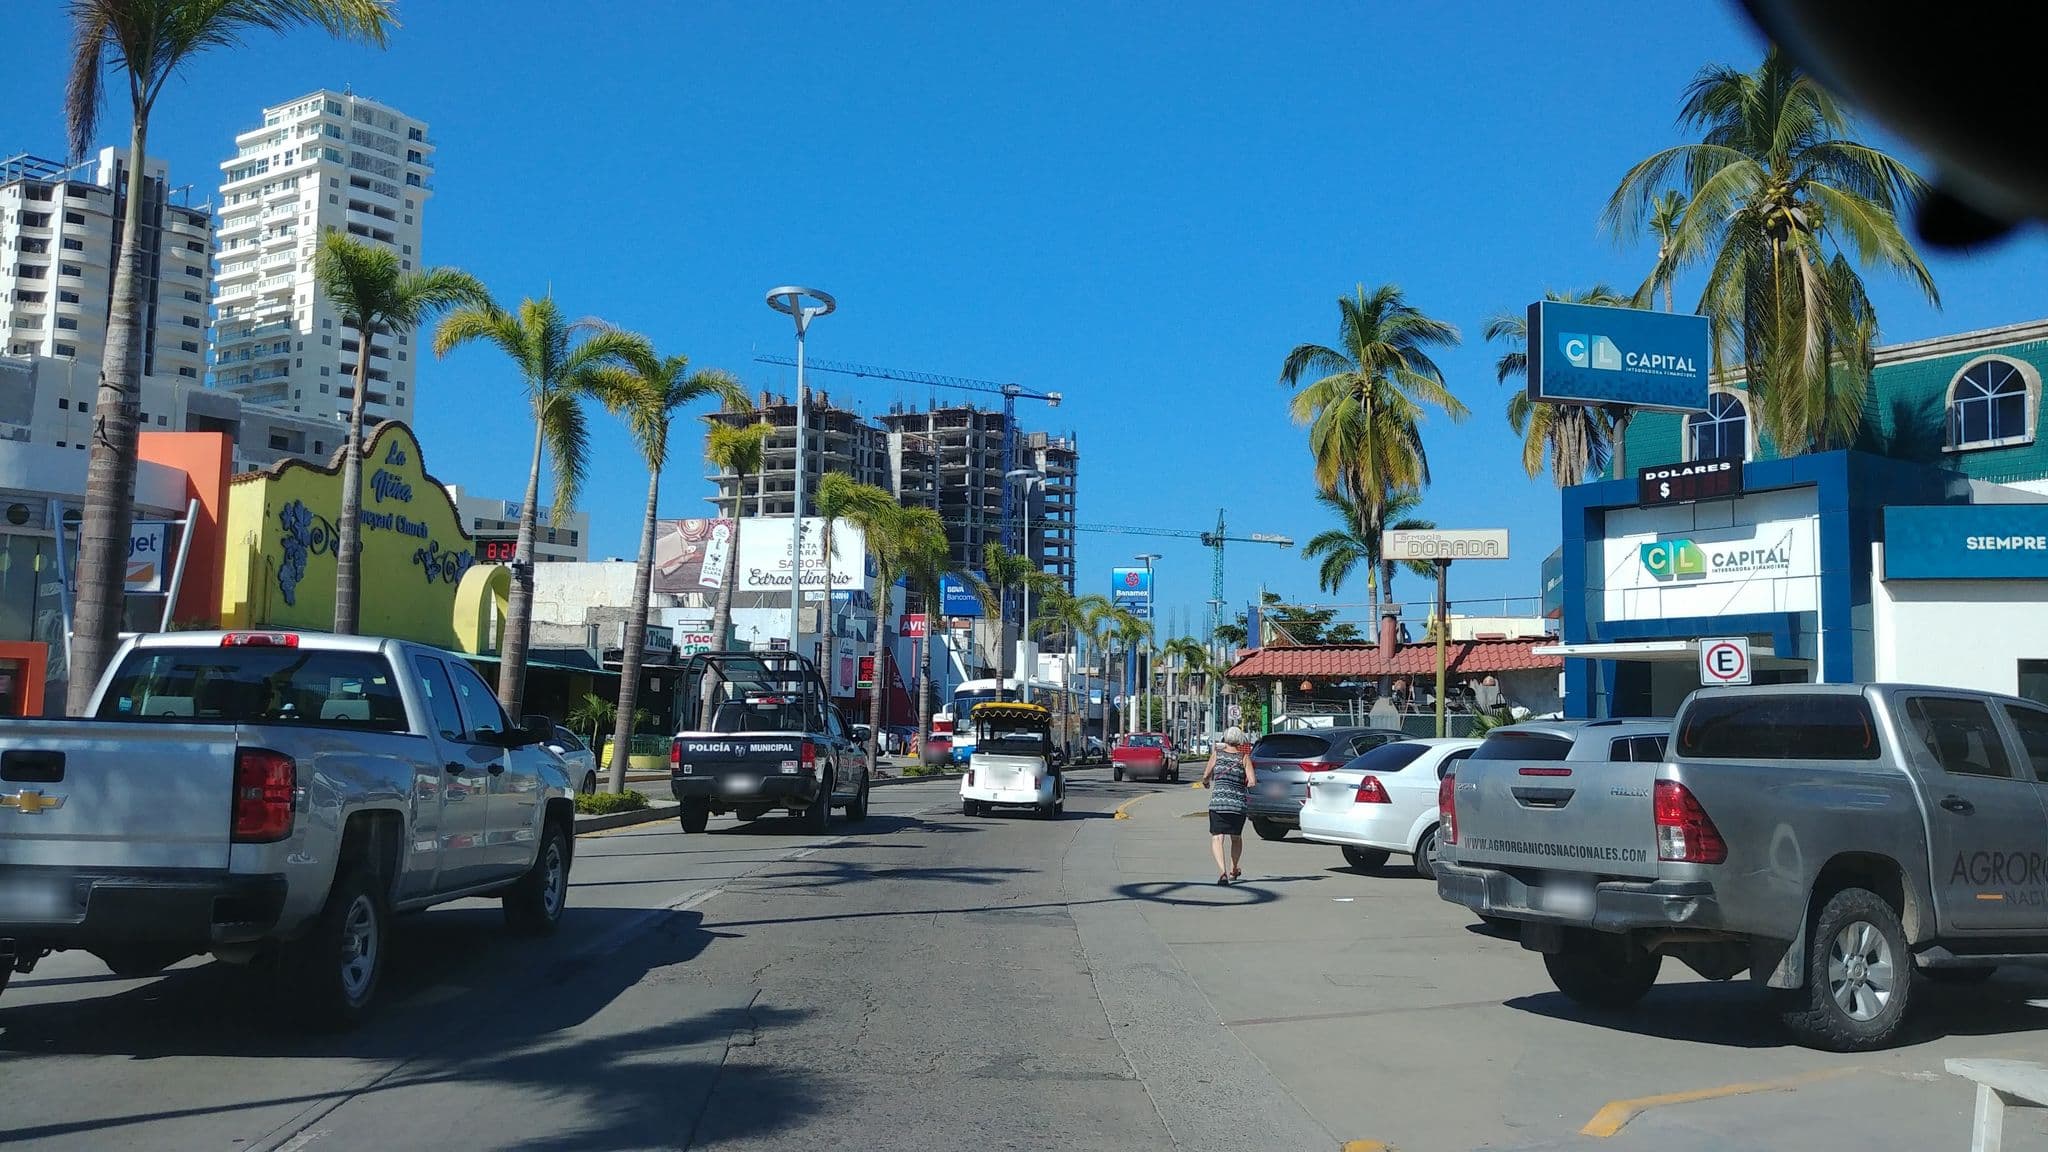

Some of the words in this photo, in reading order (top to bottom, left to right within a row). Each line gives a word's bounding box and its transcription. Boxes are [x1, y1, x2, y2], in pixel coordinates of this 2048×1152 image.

[1626, 352, 1697, 372] CAPITAL
[384, 440, 407, 466] La
[1645, 462, 1731, 480] DOLARES
[395, 514, 428, 539] Church
[1407, 540, 1499, 557] DORADA
[1966, 536, 2047, 550] SIEMPRE
[1712, 548, 1789, 568] CAPITAL
[1116, 589, 1148, 597] Banamex
[684, 644, 710, 655] Tim
[1717, 650, 1734, 672] E
[688, 742, 731, 752] POLICÍA
[749, 743, 794, 752] MUNICIPAL
[1464, 836, 1648, 863] WWW.AGRORGANICOSNACIONALES.COM
